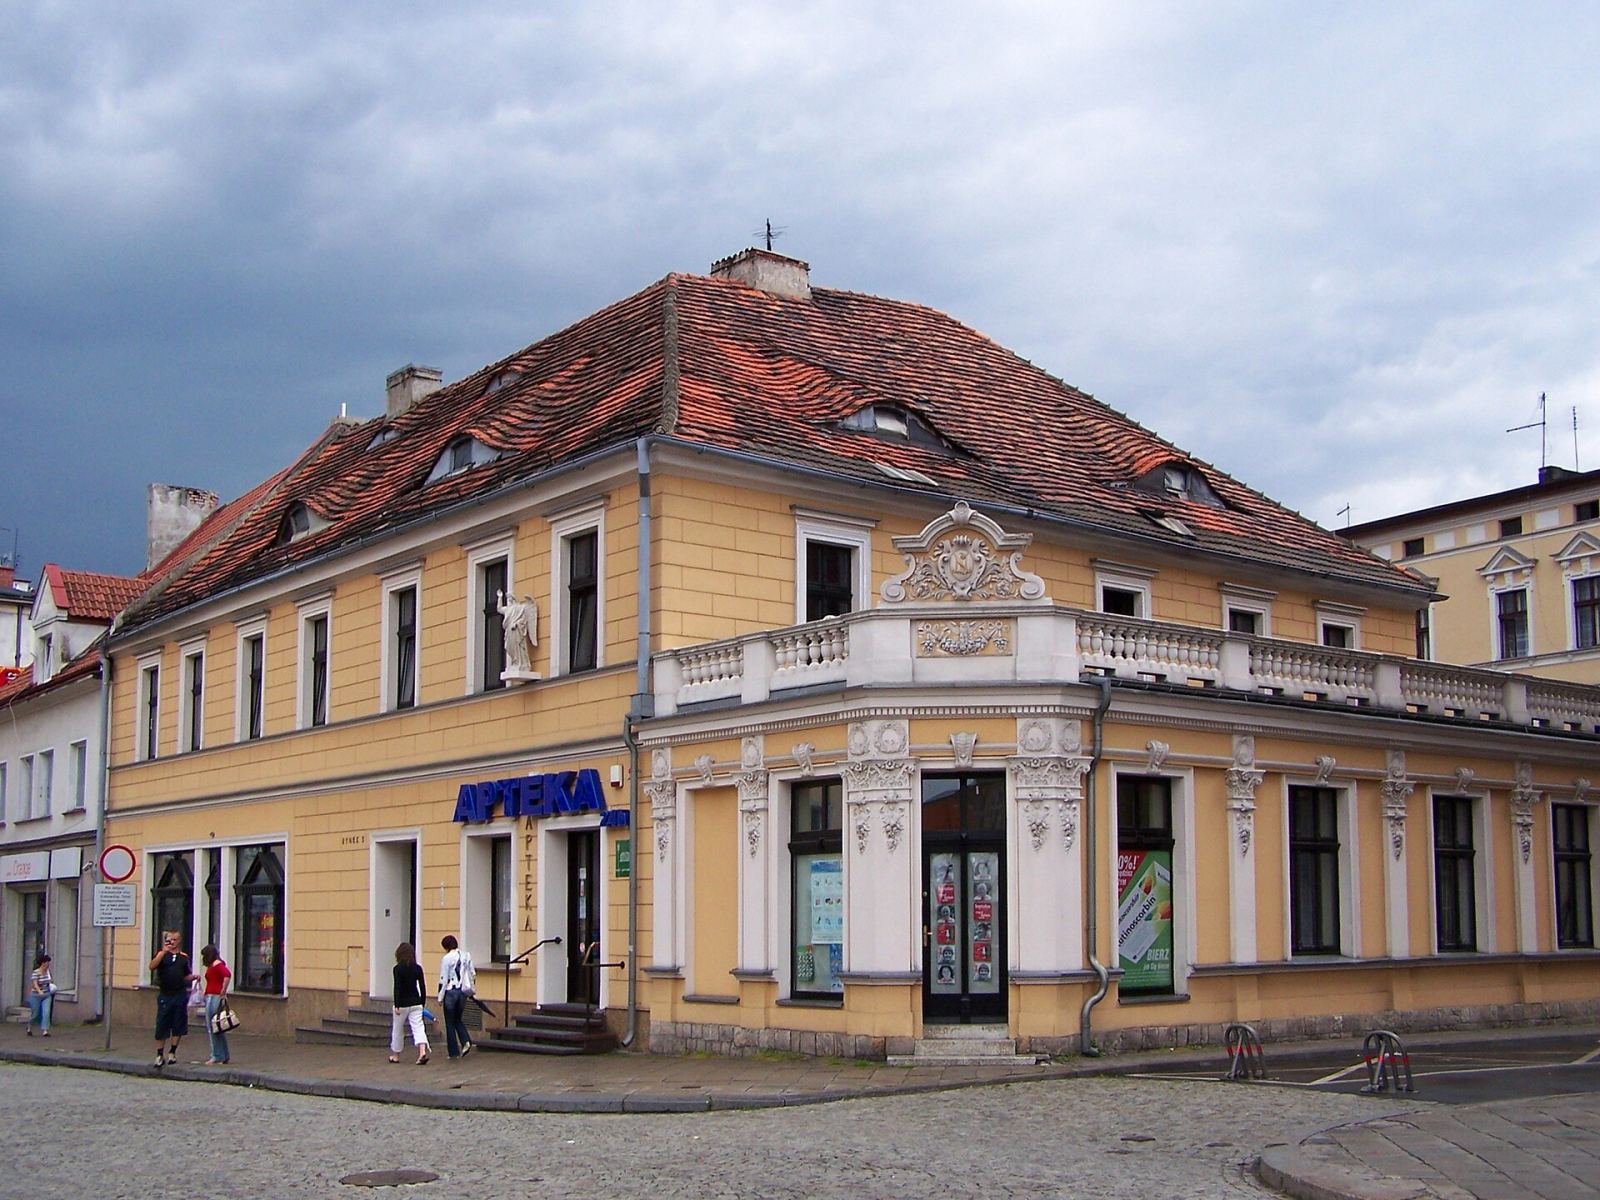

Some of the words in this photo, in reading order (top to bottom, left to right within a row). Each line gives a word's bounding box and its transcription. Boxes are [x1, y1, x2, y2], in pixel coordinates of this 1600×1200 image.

[453, 768, 607, 823] APTEKA
[525, 815, 533, 931] APTEKA
[1147, 948, 1169, 961] BIERZ
